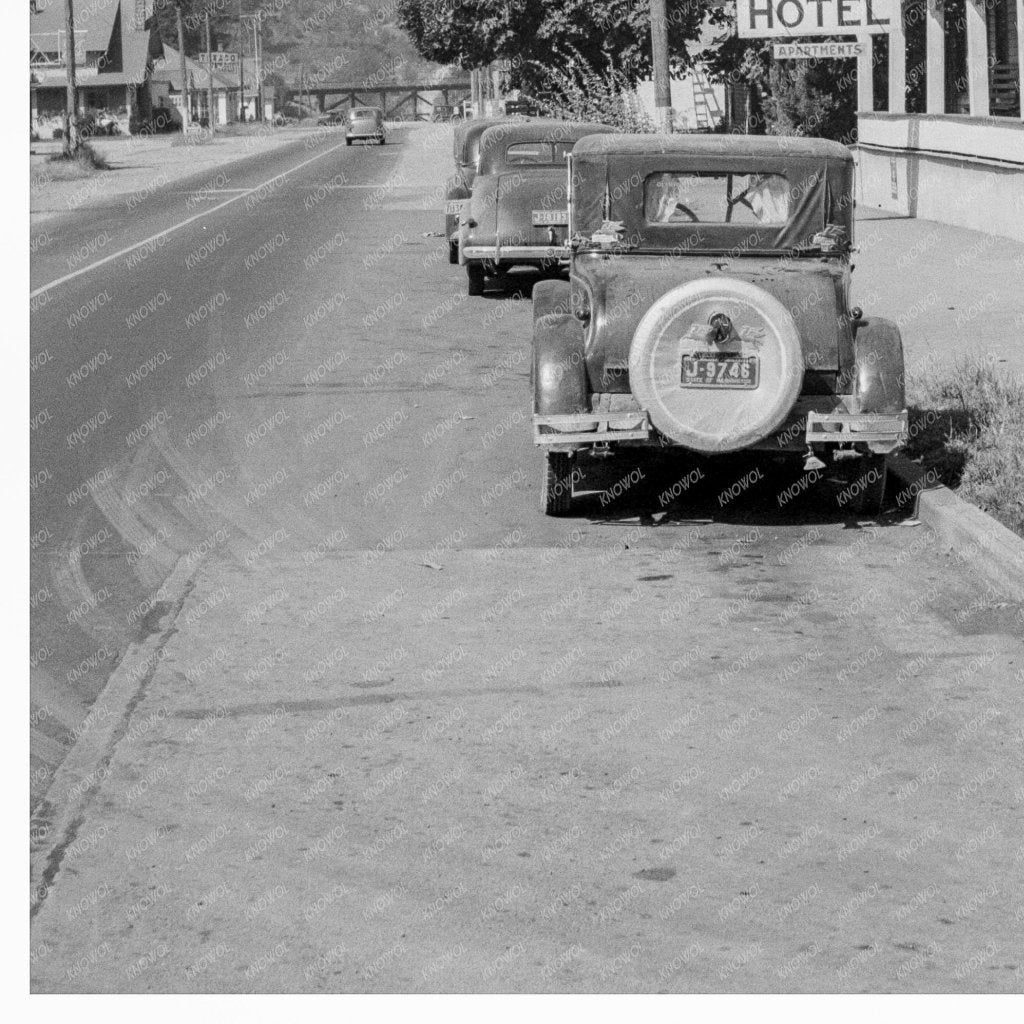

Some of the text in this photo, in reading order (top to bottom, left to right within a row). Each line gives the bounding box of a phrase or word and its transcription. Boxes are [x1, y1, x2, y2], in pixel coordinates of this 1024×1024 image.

[778, 44, 863, 57] APARTMENTS
[201, 54, 236, 62] TXACO
[685, 361, 750, 379] J-9746
